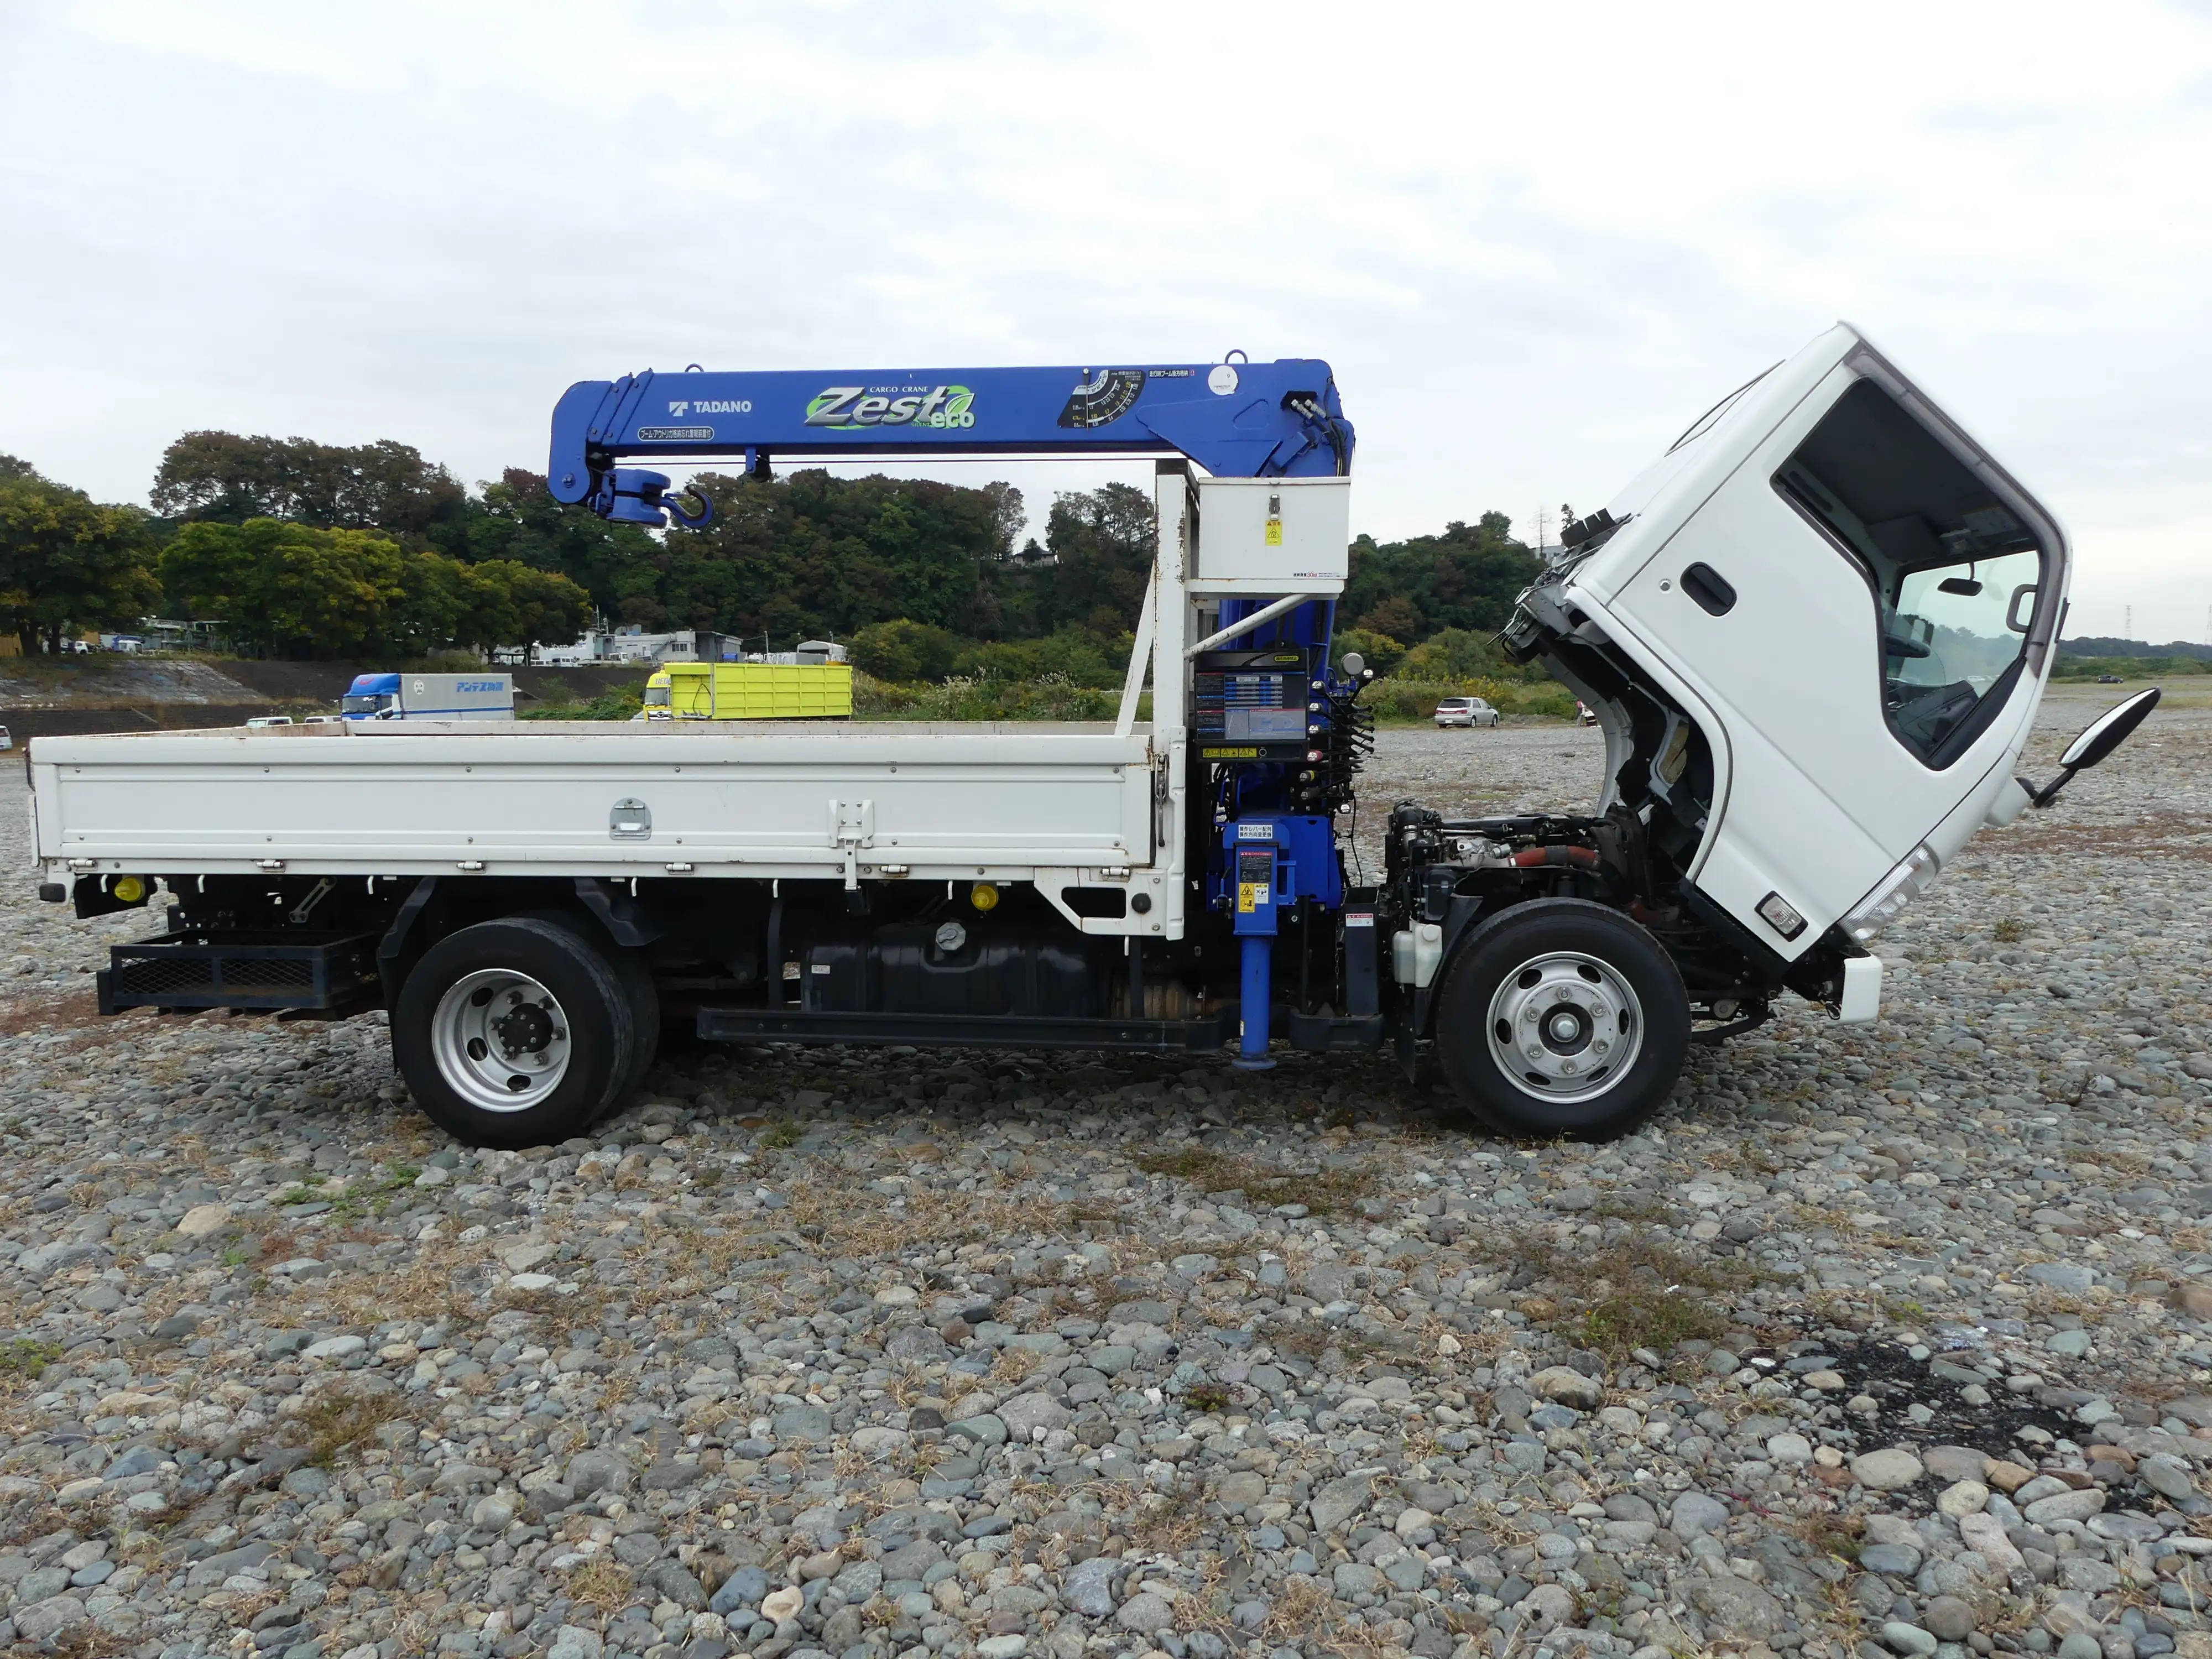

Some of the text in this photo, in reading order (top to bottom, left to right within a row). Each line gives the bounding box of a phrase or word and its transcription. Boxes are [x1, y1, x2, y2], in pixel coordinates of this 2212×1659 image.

[693, 400, 752, 413] TADANO
[804, 385, 948, 427] Zest
[930, 411, 976, 429] eco
